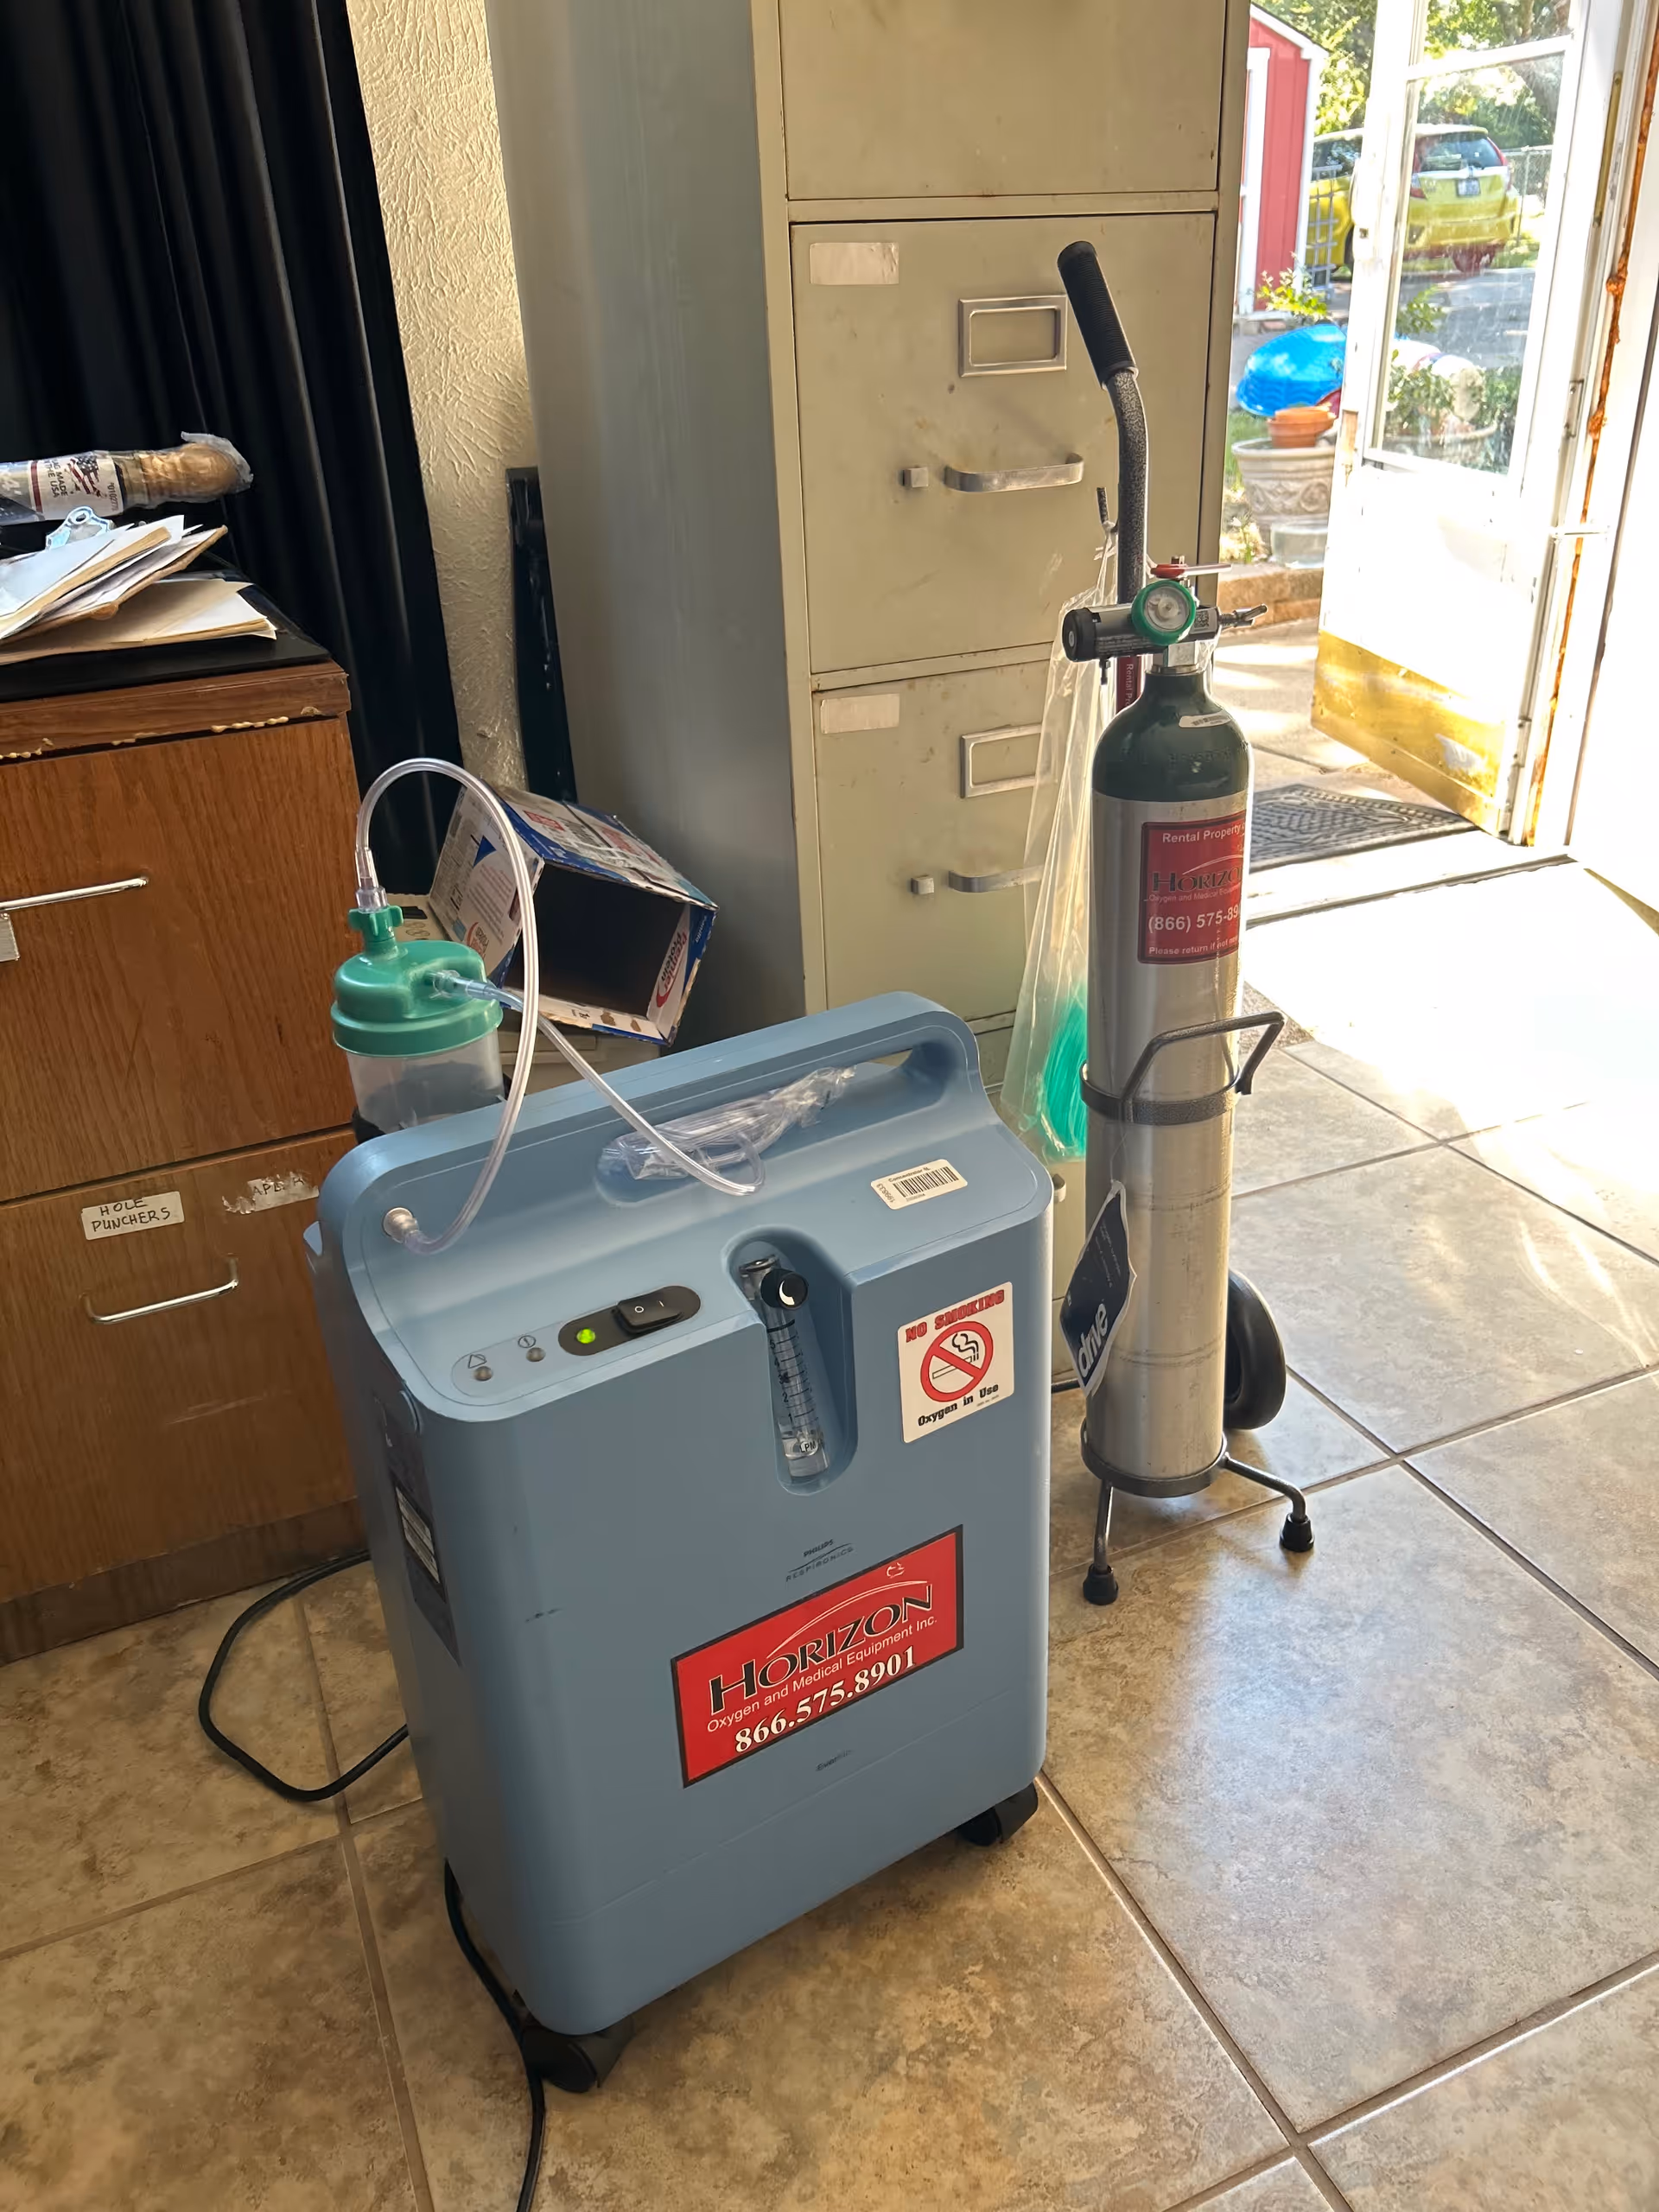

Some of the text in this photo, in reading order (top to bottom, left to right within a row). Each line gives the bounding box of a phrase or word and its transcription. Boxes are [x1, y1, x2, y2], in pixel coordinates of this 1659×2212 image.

[50, 480, 60, 499] USA
[57, 472, 68, 497] MADE
[1125, 664, 1134, 690] Rental
[1162, 832, 1200, 843] Rental
[1203, 823, 1242, 841] Property
[1149, 889, 1218, 904] Oxygen and Medical
[1148, 915, 1192, 934] (866)
[1148, 946, 1179, 955] Please
[1182, 945, 1208, 955] return
[1210, 942, 1216, 950] if
[1217, 938, 1228, 949] not
[99, 1198, 148, 1217] HOLE
[91, 1206, 171, 1232] PUNCHERS
[905, 1289, 1005, 1343] NO SMOKING
[1077, 1302, 1109, 1377] drive
[782, 1392, 789, 1402] 2
[917, 1402, 958, 1427] Oxygen
[963, 1395, 974, 1407] in
[979, 1383, 1000, 1398] Use
[799, 1441, 817, 1453] LPM
[803, 1539, 834, 1557] PHILIPS
[709, 1583, 932, 1716] HORIZON
[707, 1615, 938, 1732] Oxygen and Medical Equipment Inc.
[734, 1645, 917, 1753] 866.575.8901
